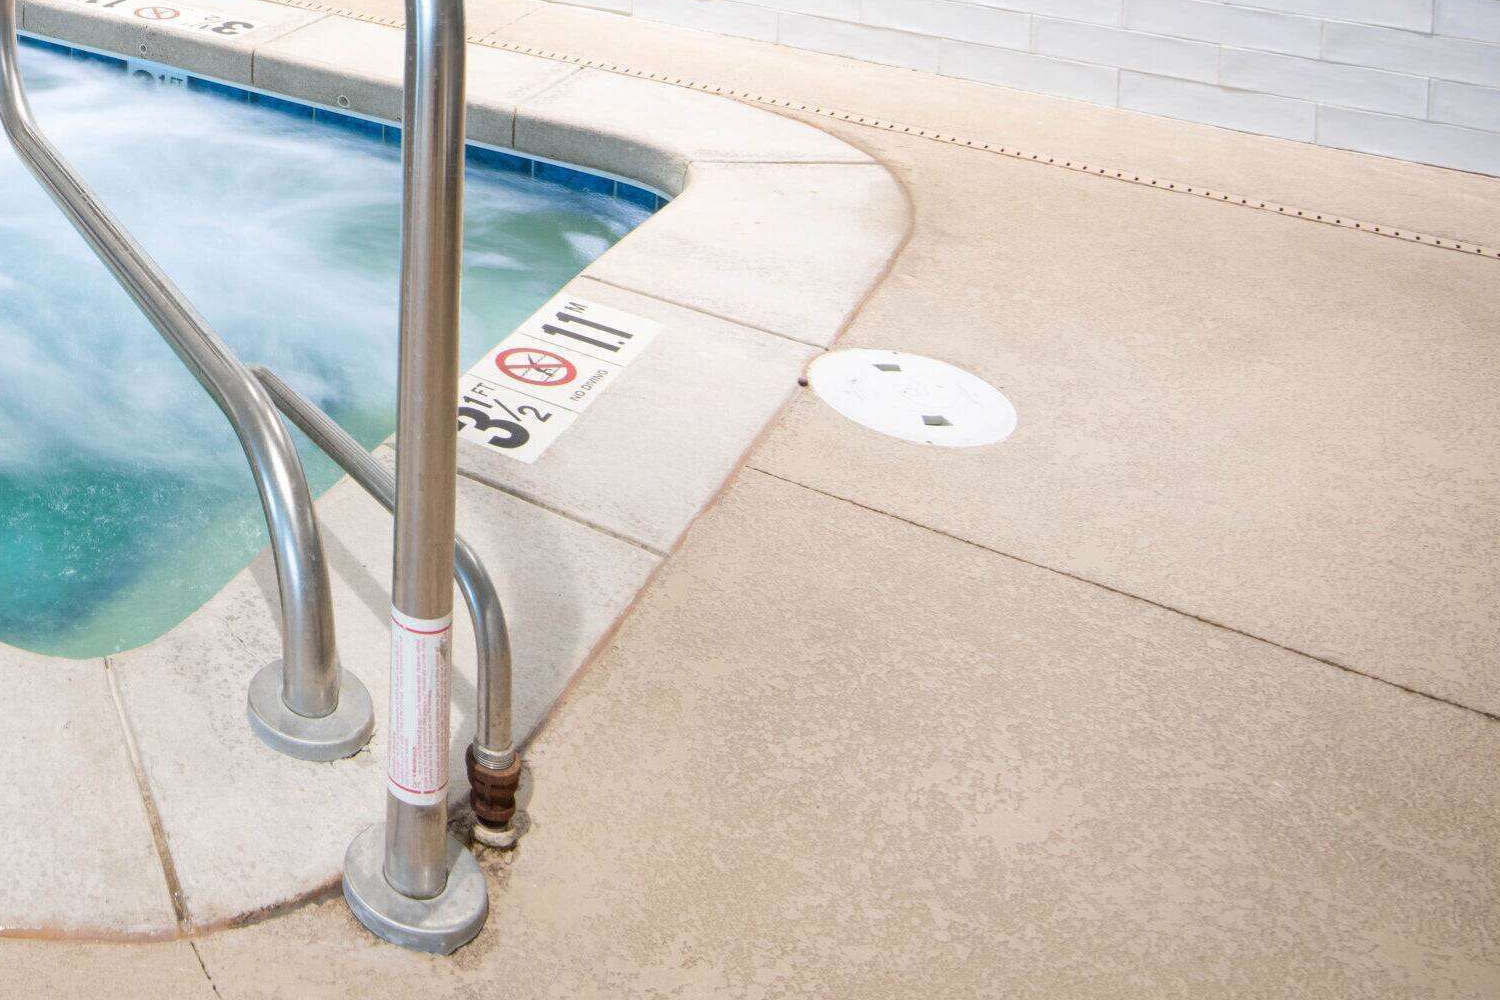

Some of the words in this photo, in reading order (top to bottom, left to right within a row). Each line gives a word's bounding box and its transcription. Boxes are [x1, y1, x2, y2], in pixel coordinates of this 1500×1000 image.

[564, 301, 588, 314] M
[541, 311, 634, 353] 1.1
[470, 382, 496, 398] FT
[569, 388, 587, 402] NO
[580, 368, 610, 391] DIVING
[457, 406, 531, 449] 3
